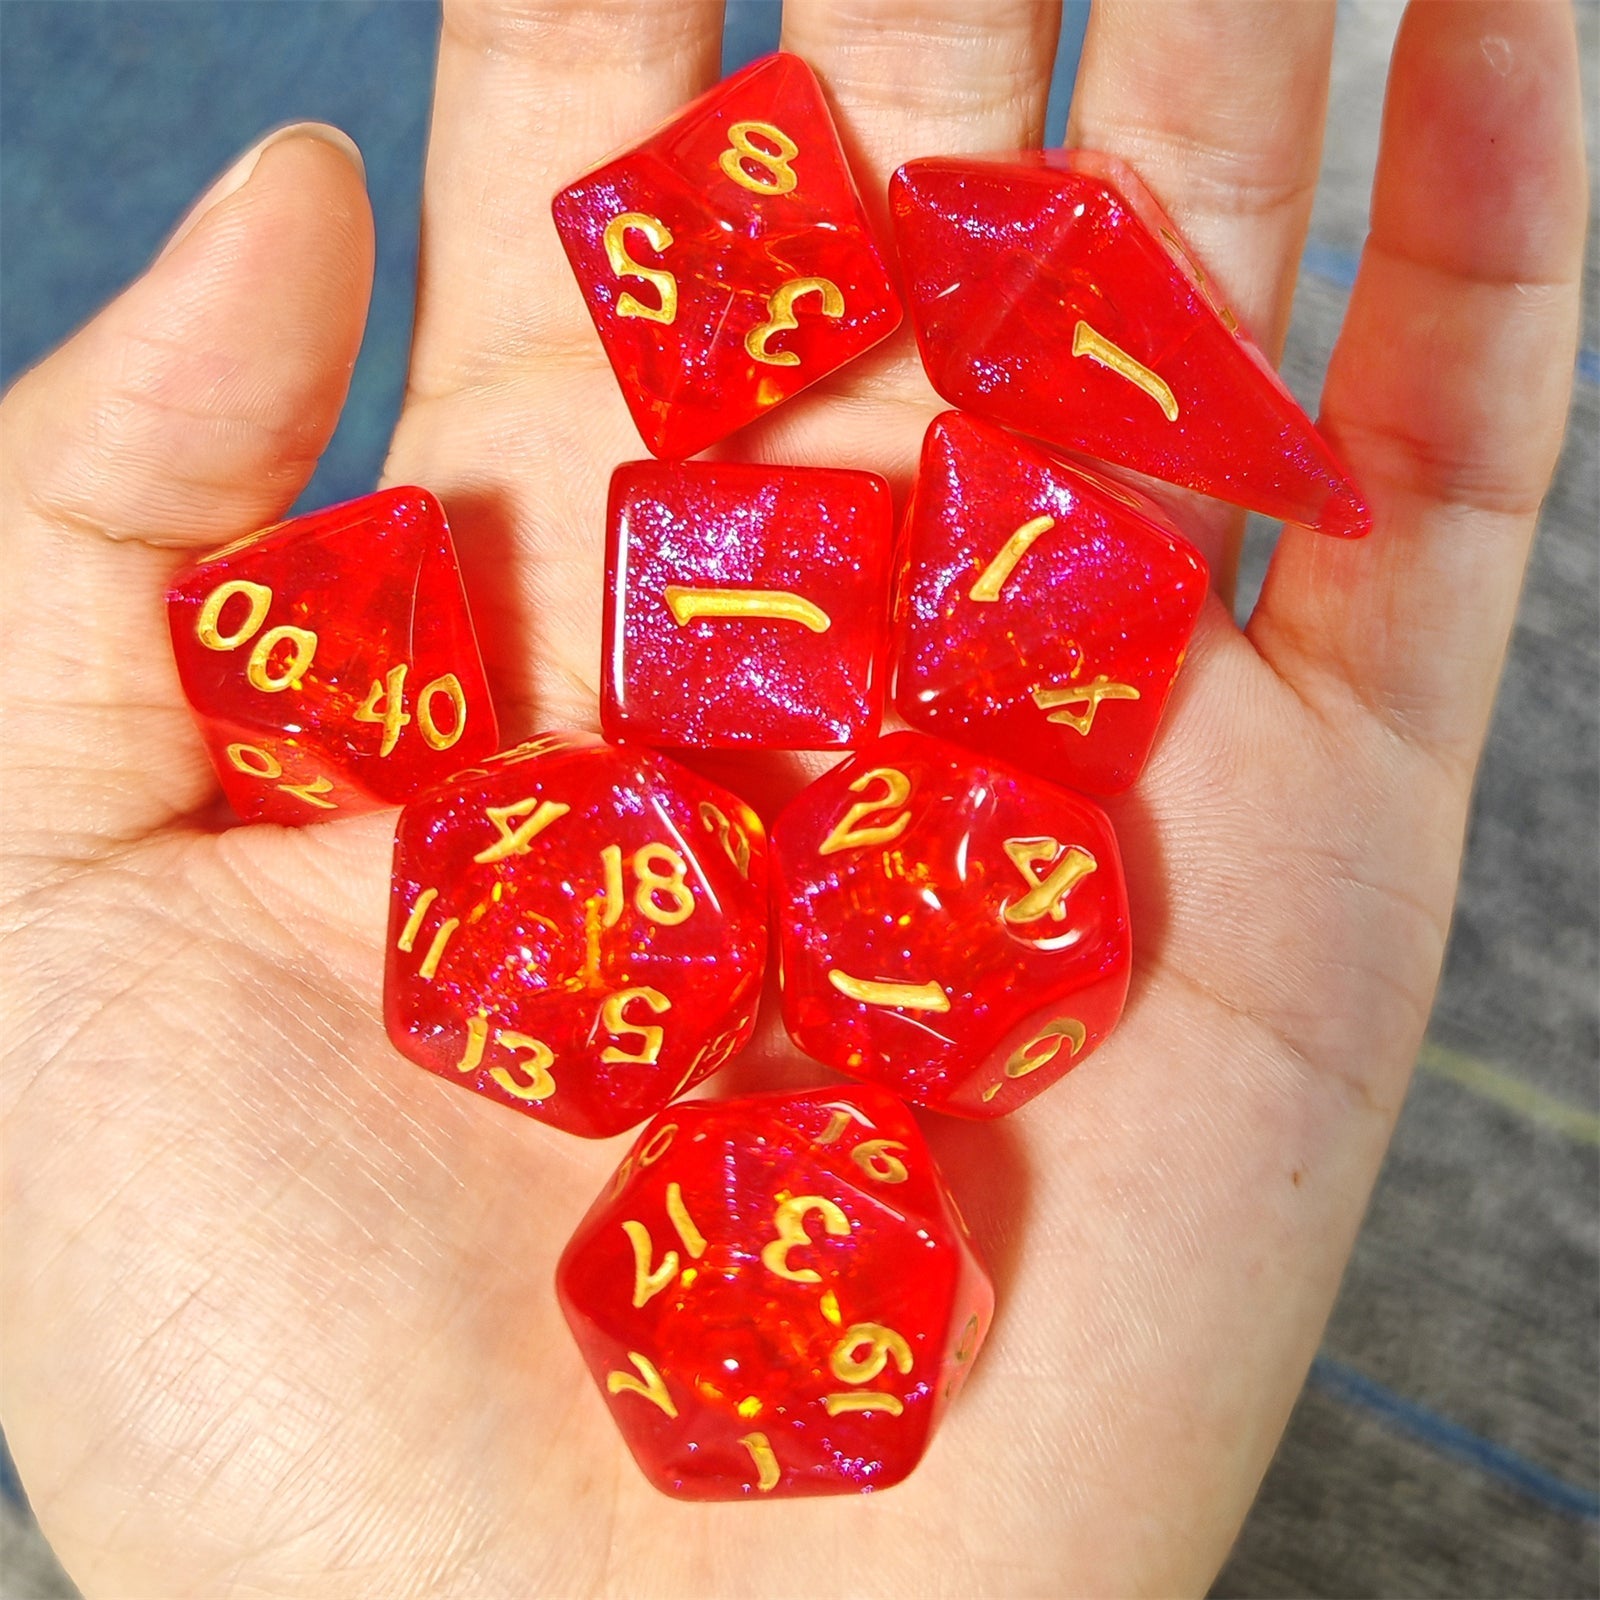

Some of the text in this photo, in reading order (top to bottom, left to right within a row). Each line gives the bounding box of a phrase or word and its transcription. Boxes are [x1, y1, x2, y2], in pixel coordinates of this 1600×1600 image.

[719, 121, 799, 196] 8
[603, 212, 678, 326] 5
[744, 277, 845, 367] 3
[1072, 320, 1179, 422] 1
[968, 515, 1056, 602] 1
[196, 579, 318, 693] 00
[664, 585, 831, 634] 1
[352, 663, 467, 758] 40
[1031, 675, 1141, 736] 4
[473, 797, 571, 864] 4
[819, 767, 912, 855] 2
[594, 842, 696, 928] 18
[1002, 837, 1098, 924] 4
[397, 887, 460, 979] 11
[601, 986, 672, 1065] 5
[828, 969, 951, 1014] 1
[455, 1017, 556, 1101] 13
[813, 1111, 909, 1183] 16
[621, 1182, 708, 1308] 17
[761, 1195, 852, 1283] 3
[606, 1351, 679, 1419] 7
[825, 1322, 914, 1418] 19
[738, 1431, 781, 1492] 1
